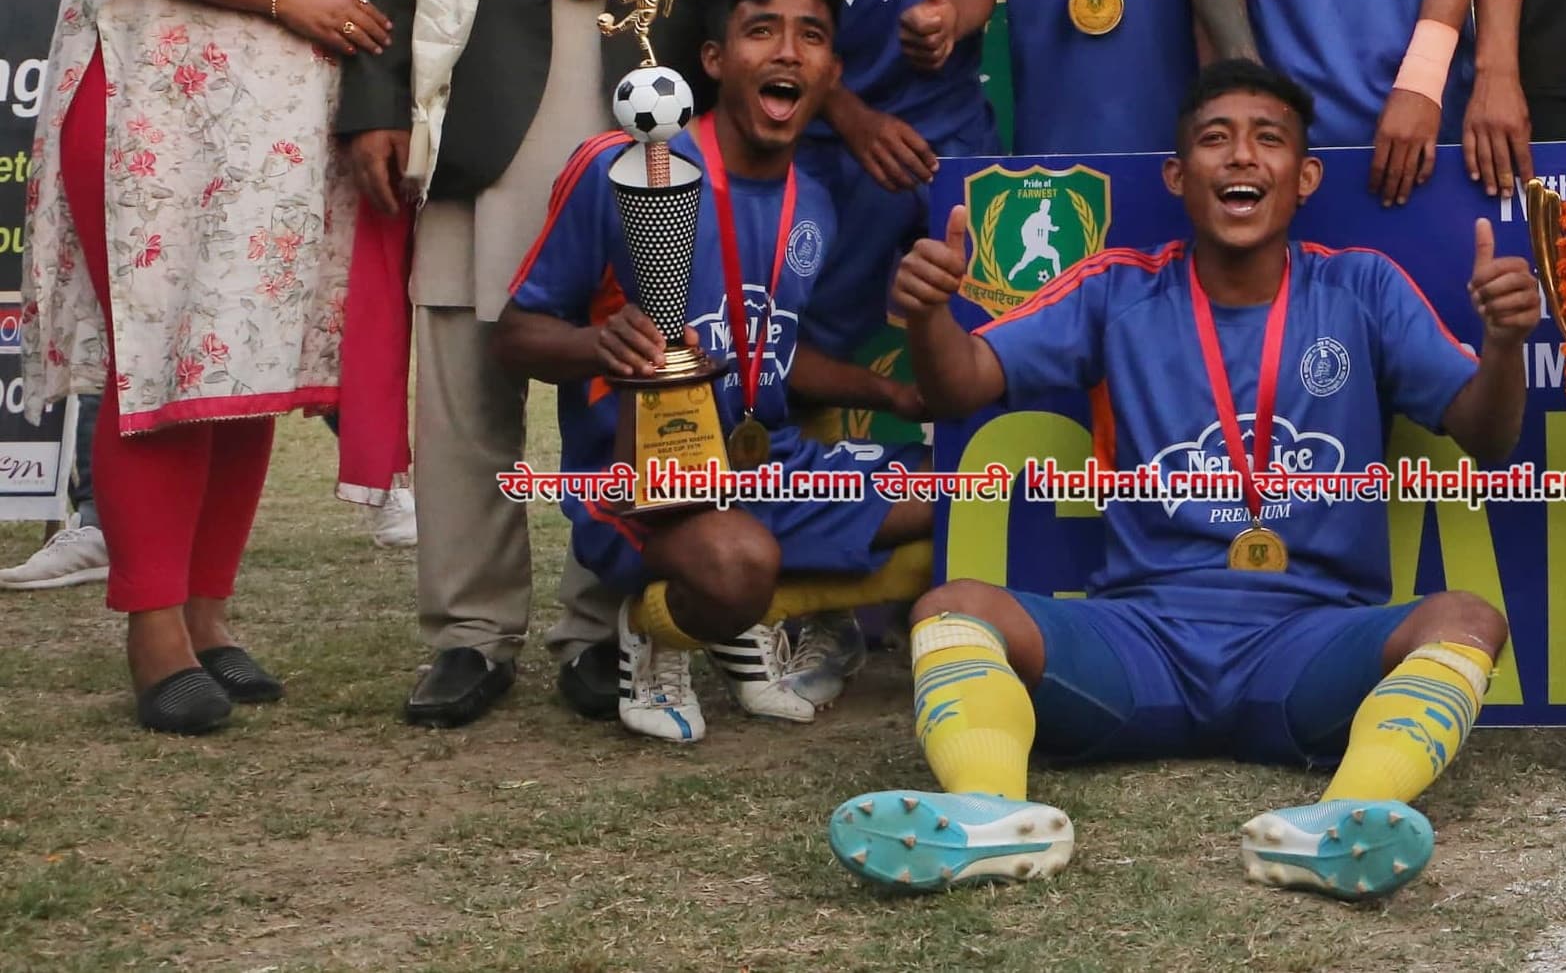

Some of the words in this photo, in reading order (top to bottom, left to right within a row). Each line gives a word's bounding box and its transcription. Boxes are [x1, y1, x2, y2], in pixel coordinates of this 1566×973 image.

[1023, 179, 1043, 189] Pride
[1044, 179, 1052, 189] of
[1017, 189, 1059, 199] FARWEST
